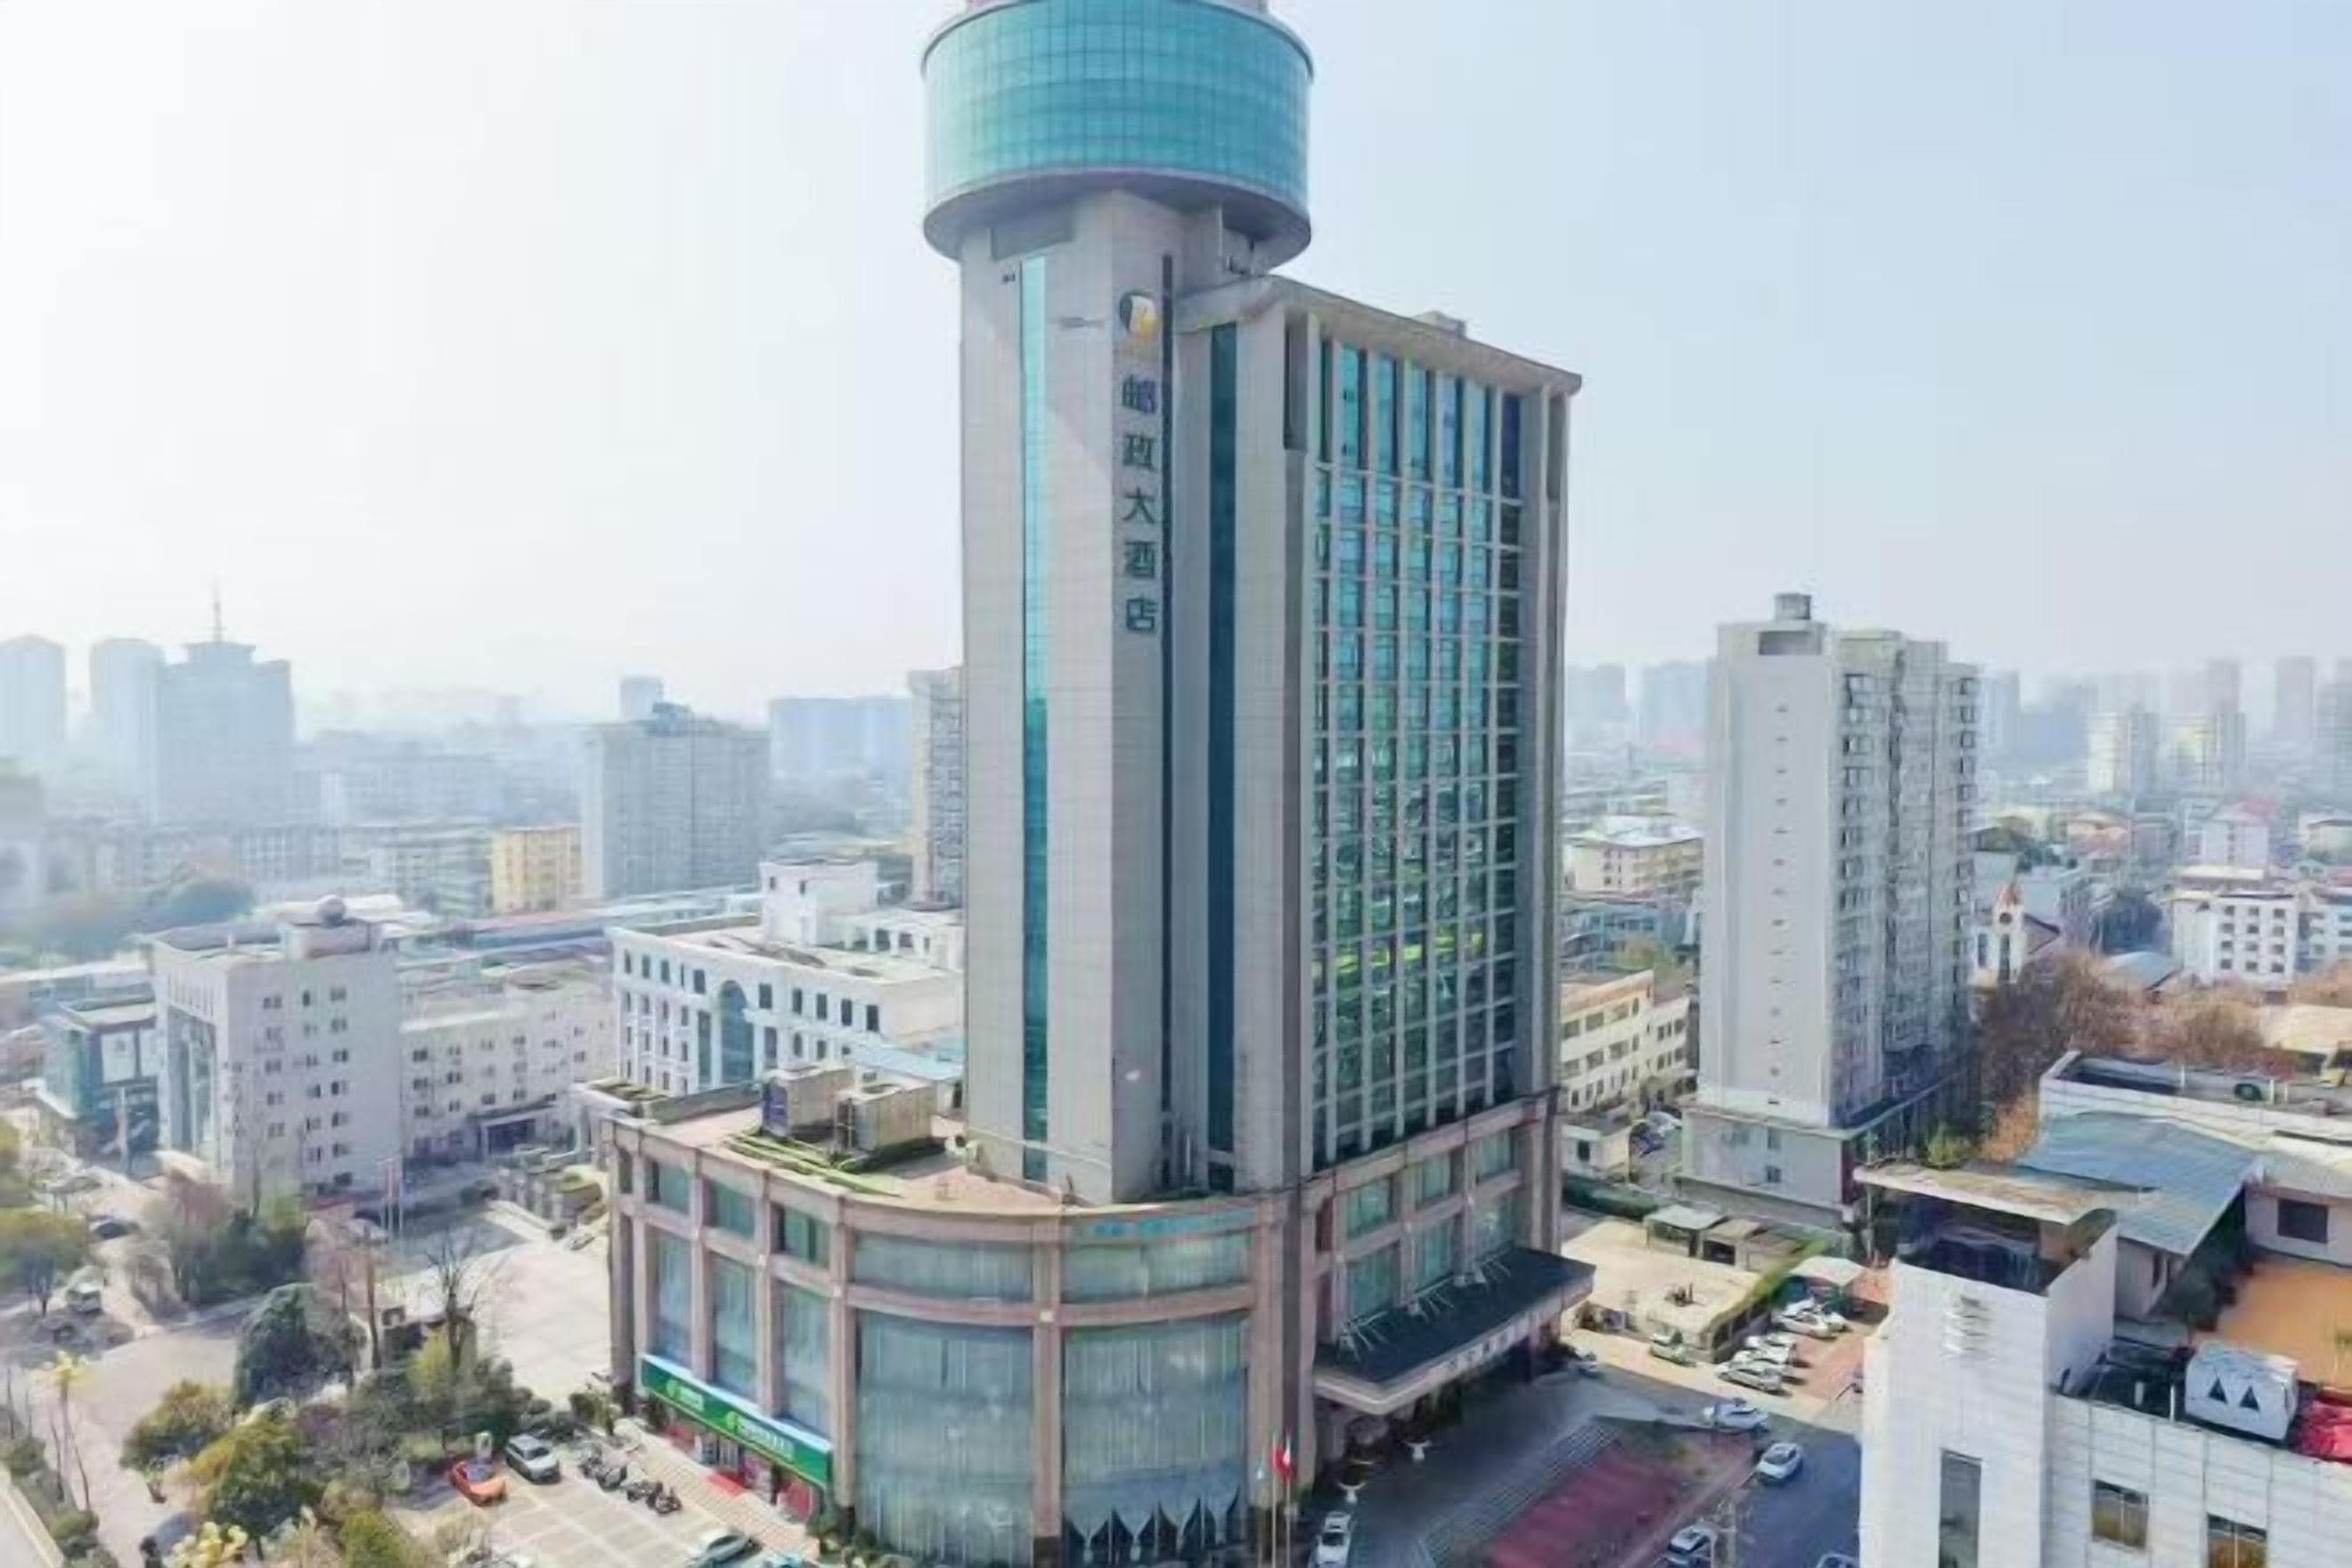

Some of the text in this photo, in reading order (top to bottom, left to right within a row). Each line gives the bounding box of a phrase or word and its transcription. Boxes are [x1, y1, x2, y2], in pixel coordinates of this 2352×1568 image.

[1122, 374, 1157, 632] 邮政大酒店
